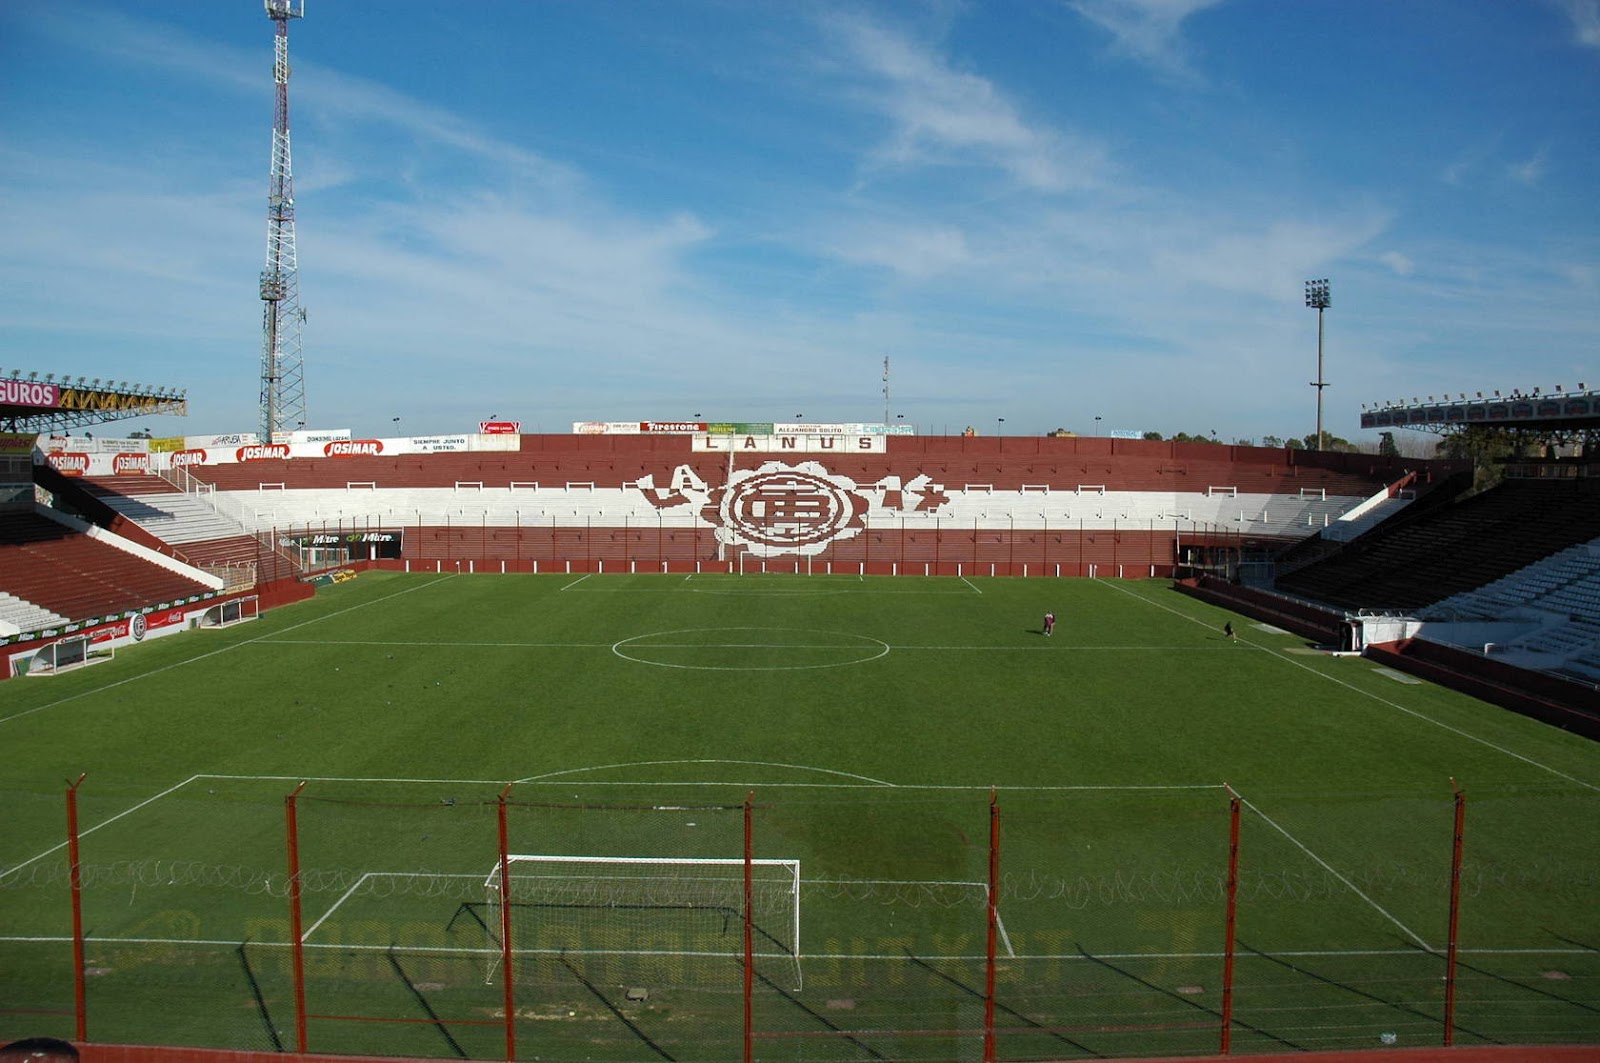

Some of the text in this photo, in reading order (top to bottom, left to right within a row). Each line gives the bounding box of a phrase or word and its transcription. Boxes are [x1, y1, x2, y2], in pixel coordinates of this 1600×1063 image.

[647, 423, 700, 431] Firestone
[327, 441, 379, 457] JOSIMAR
[705, 436, 873, 450] LANUS
[240, 445, 289, 463] JOSIMAR
